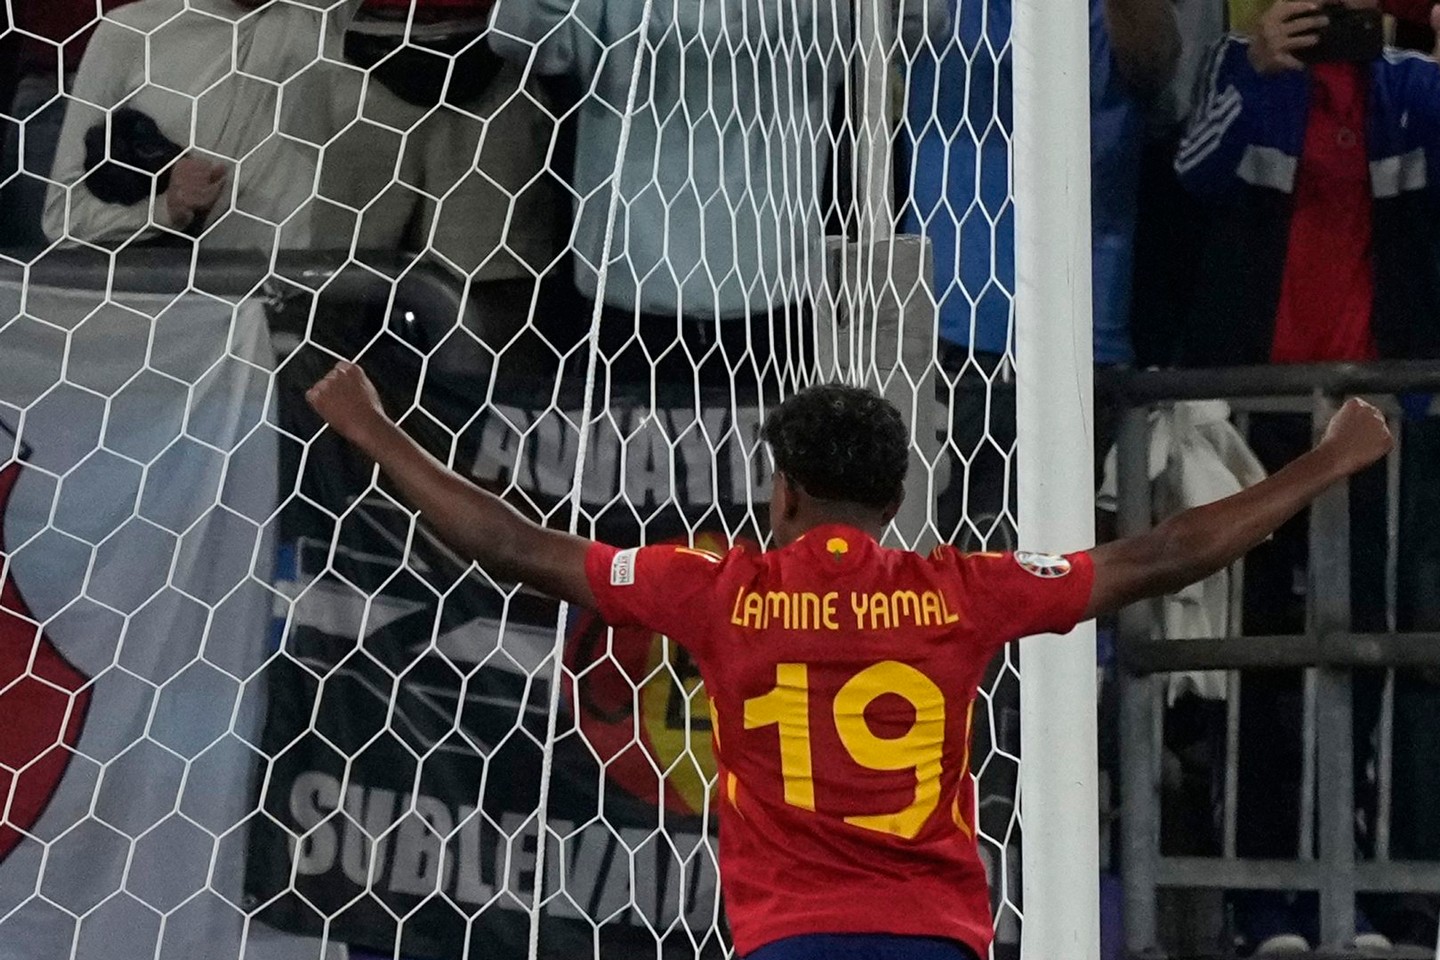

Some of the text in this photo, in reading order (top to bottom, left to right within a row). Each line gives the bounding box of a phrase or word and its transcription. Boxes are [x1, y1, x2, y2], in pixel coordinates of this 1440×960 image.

[731, 586, 959, 630] LAMINE YAMAL
[743, 660, 945, 839] 19
